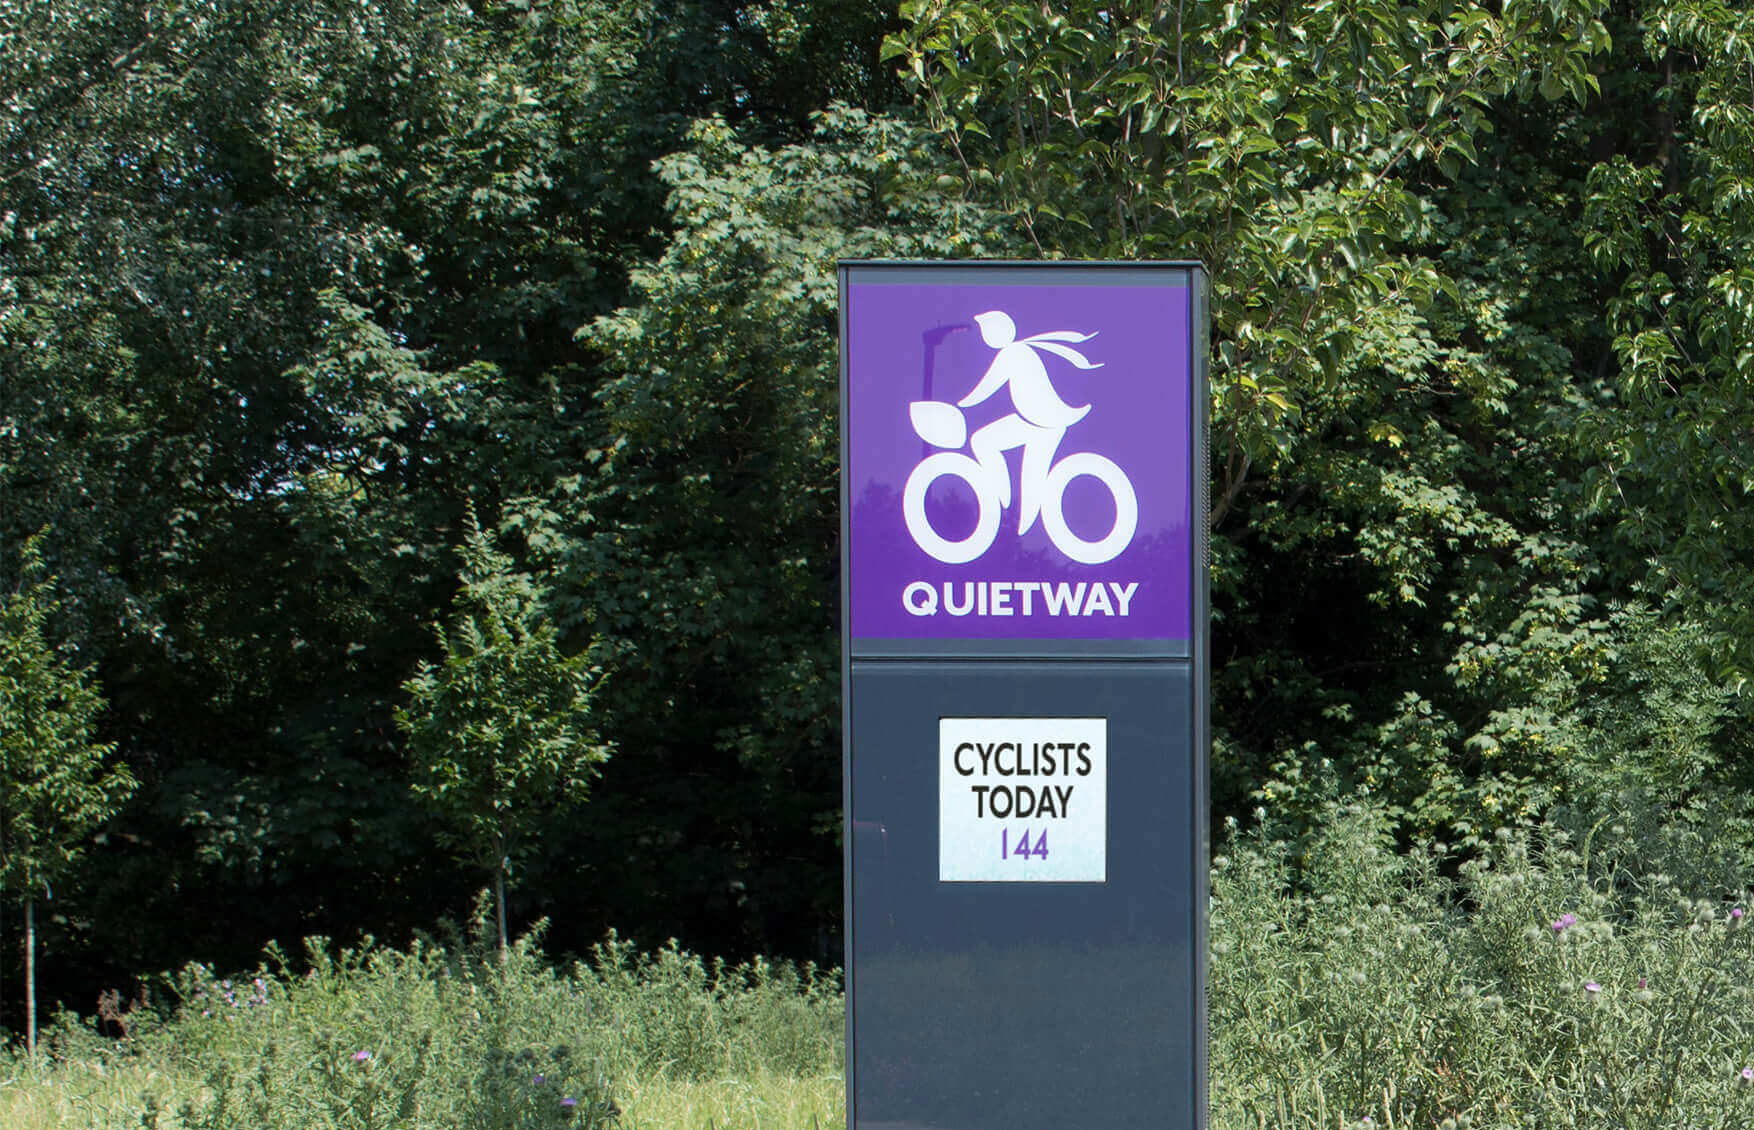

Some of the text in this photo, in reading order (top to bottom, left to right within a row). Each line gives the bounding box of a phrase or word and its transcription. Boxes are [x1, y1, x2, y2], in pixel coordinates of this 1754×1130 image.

[902, 580, 1139, 617] QUIETWAY
[953, 741, 1093, 777] CYCLISTS
[971, 784, 1074, 819] TODAY
[1000, 827, 1050, 861] 144
